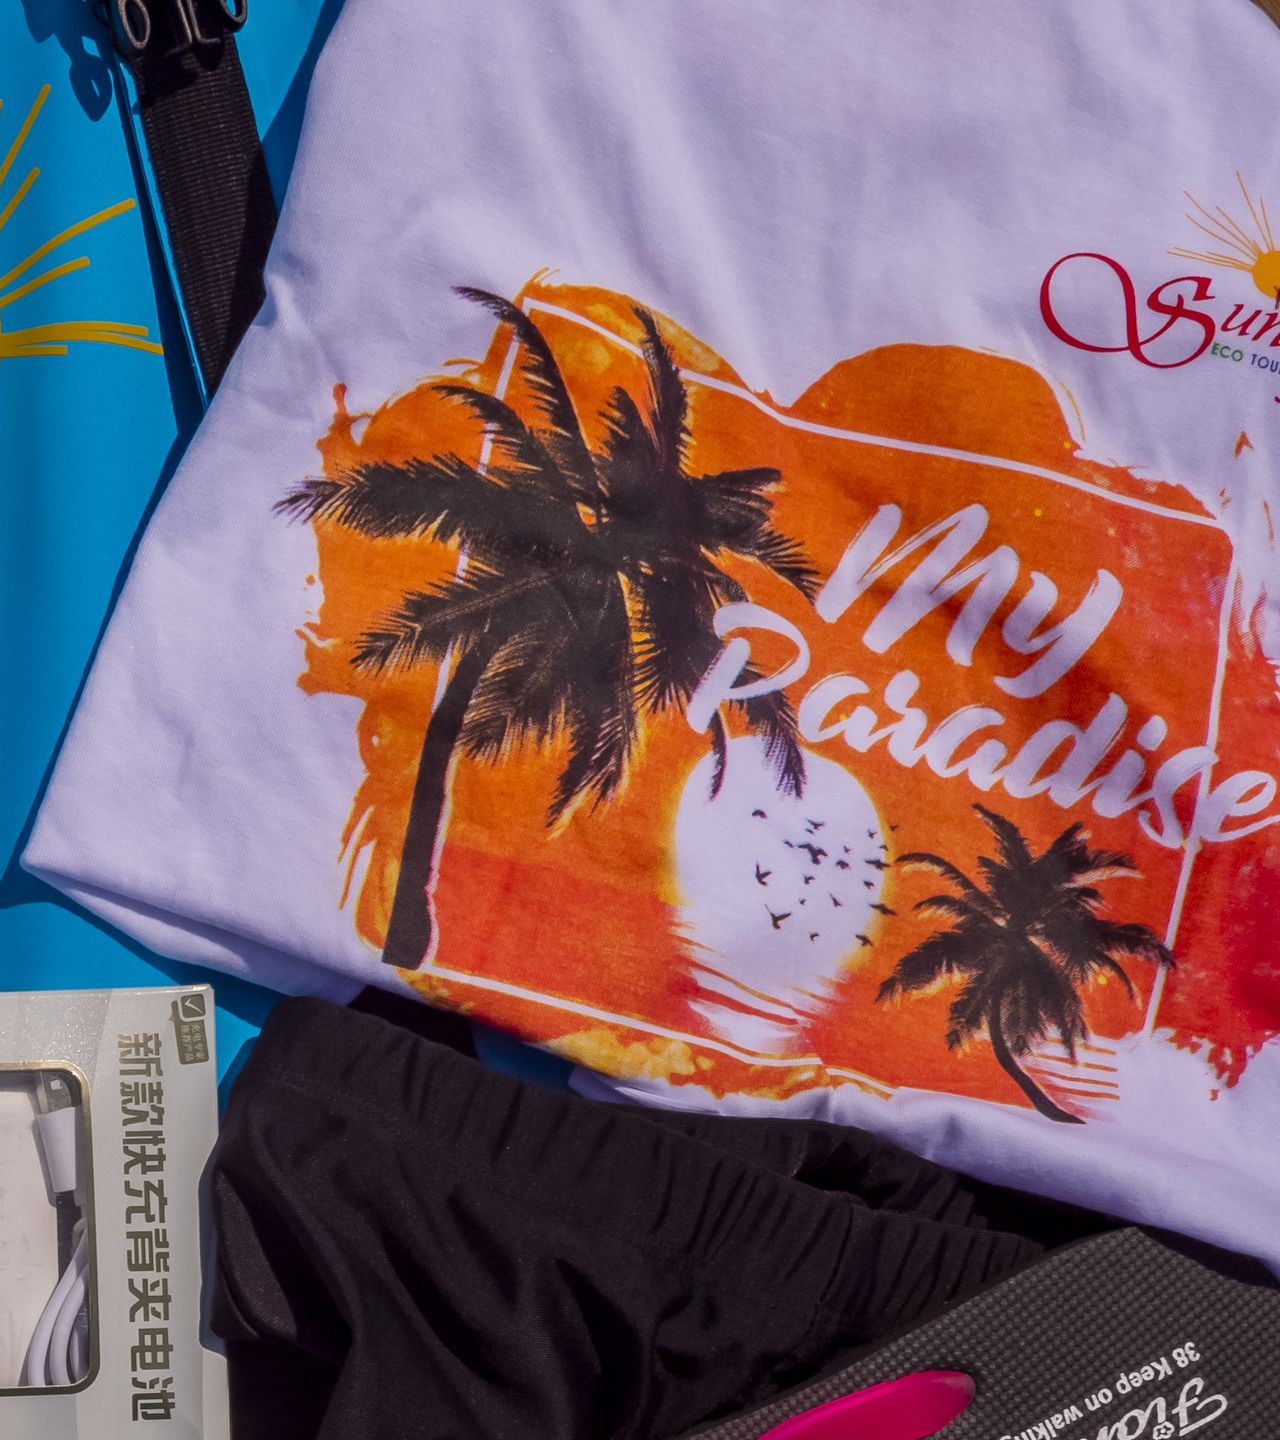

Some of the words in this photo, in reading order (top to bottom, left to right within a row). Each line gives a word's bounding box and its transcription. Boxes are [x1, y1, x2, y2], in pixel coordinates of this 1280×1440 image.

[1210, 342, 1244, 363] ECO
[814, 503, 1124, 699] My
[686, 602, 1280, 849] Paradise
[117, 1032, 175, 1422] 新款快充背夹电池
[1171, 1341, 1201, 1368] 38
[1115, 1357, 1174, 1395] Keep
[1084, 1388, 1113, 1412] on
